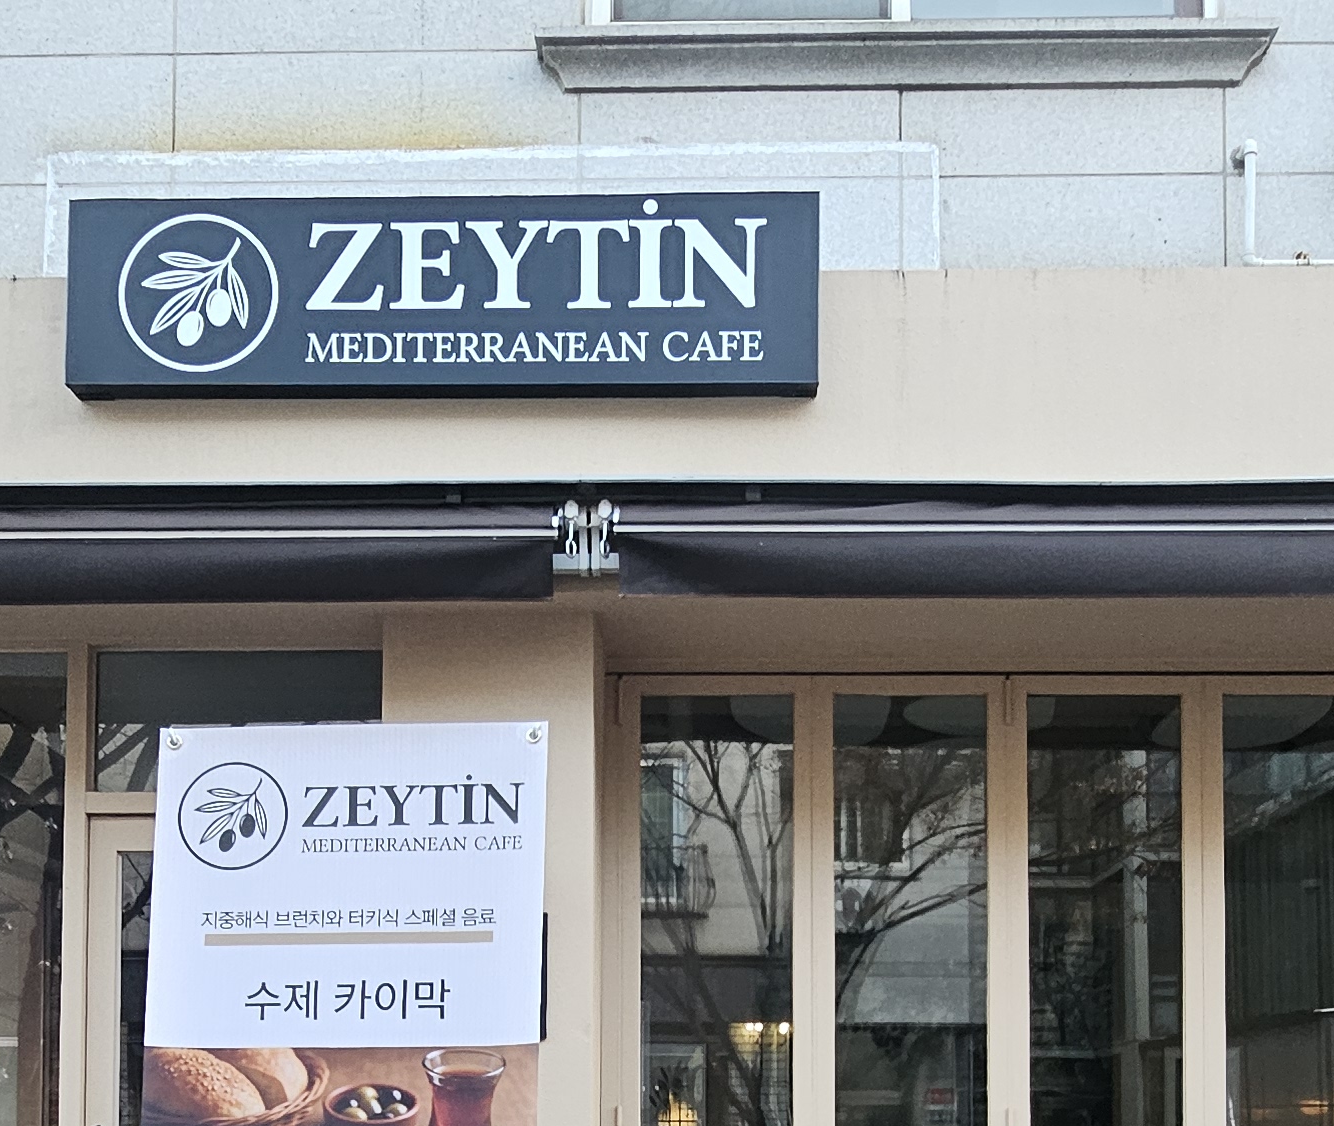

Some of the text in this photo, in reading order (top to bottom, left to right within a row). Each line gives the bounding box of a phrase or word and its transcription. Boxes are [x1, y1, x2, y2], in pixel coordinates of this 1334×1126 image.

[304, 329, 764, 363] MEDITERRANEAN CAFE
[301, 835, 523, 854] MEDITERRANEAN CAFE
[200, 907, 497, 930] 지중해식 브런치와 터키식 스페셜 음료
[244, 978, 451, 1021] 수제 카이막
